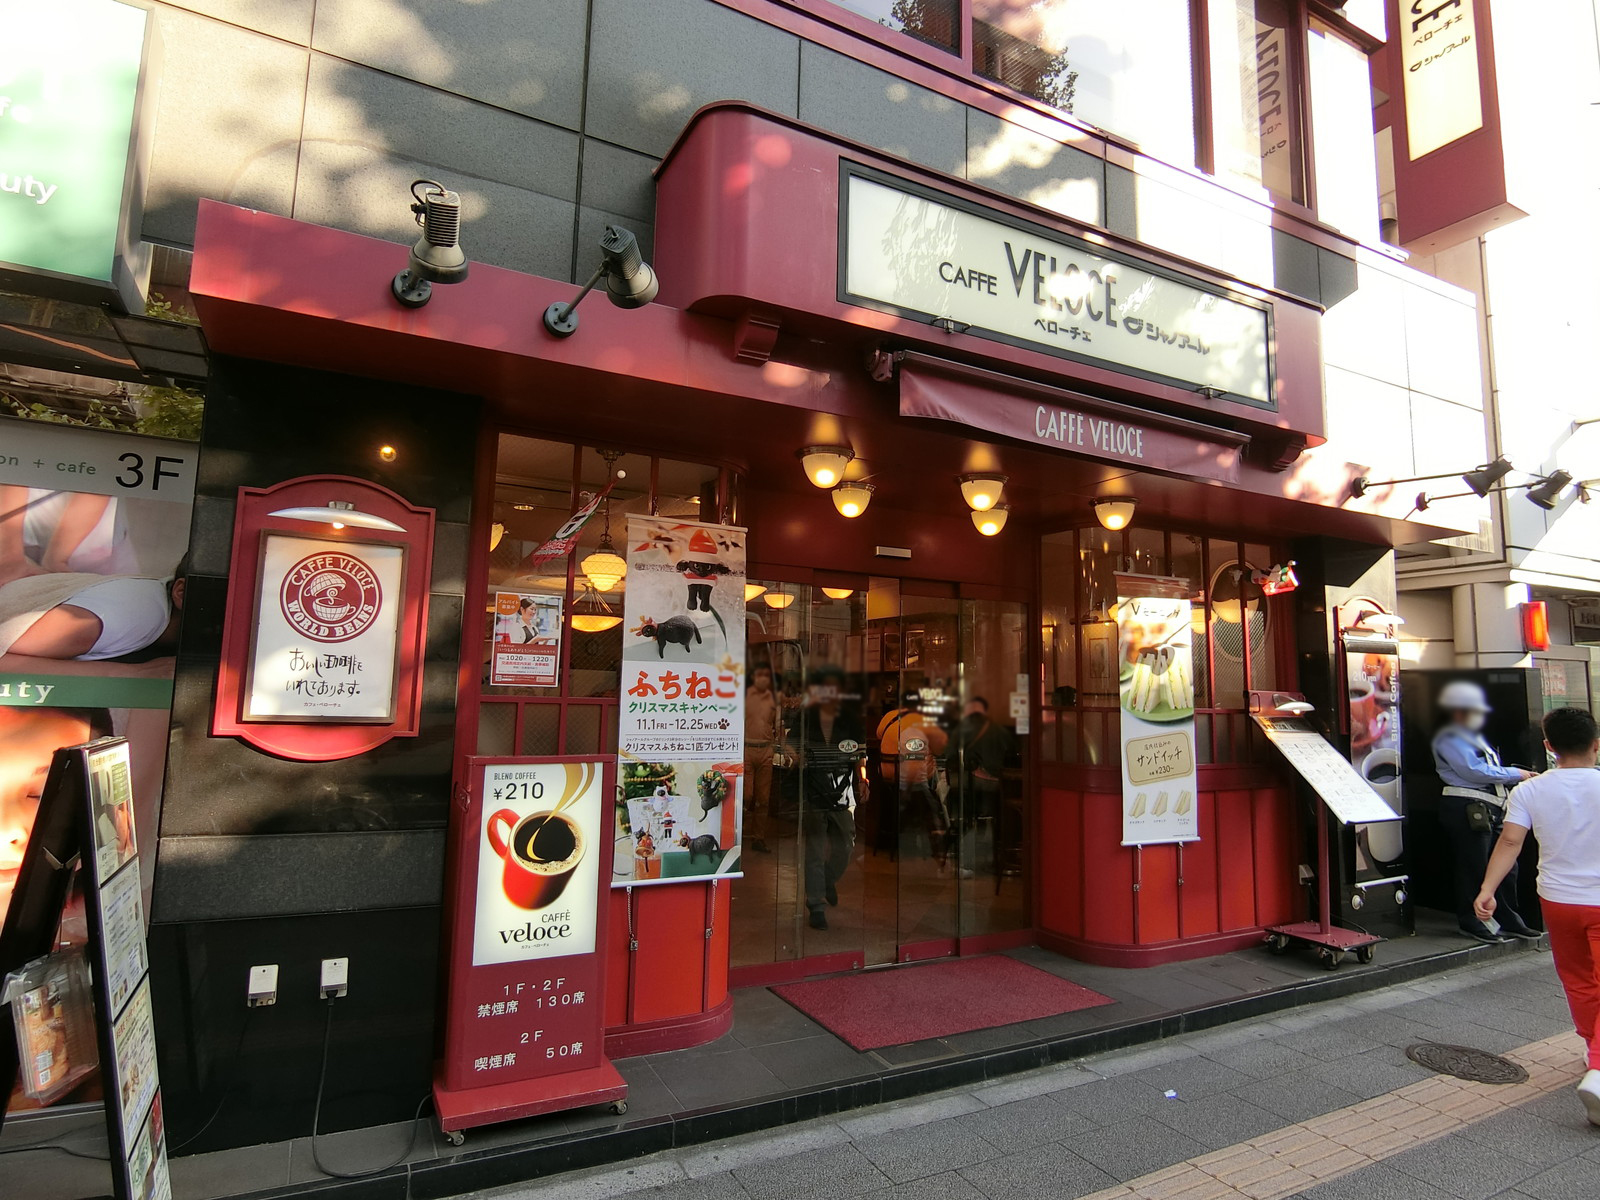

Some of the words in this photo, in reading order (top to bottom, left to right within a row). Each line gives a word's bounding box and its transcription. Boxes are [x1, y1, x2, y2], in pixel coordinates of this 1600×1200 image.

[939, 261, 998, 296] CAFFE
[1003, 241, 1118, 328] VELOCE
[1034, 318, 1092, 343] ベローチェ
[1035, 405, 1084, 446] CAFFÈ
[1089, 418, 1143, 458] VELOCE
[56, 461, 97, 475] cafe
[115, 452, 184, 492] 3F
[339, 558, 375, 590] VELOCE
[287, 600, 329, 637] WORLD
[335, 603, 374, 637] BEANS
[627, 670, 736, 700] ふちねこ
[628, 701, 738, 714] クリスマスキャンペーン
[1137, 745, 1182, 767] サンドイッチ
[494, 772, 512, 781] BLEND
[514, 771, 537, 780] COFFEE
[498, 921, 572, 945] veloce
[477, 1000, 519, 1018] 禁煙席
[520, 1030, 544, 1044] 2F
[474, 1052, 517, 1072] 喫煙席
